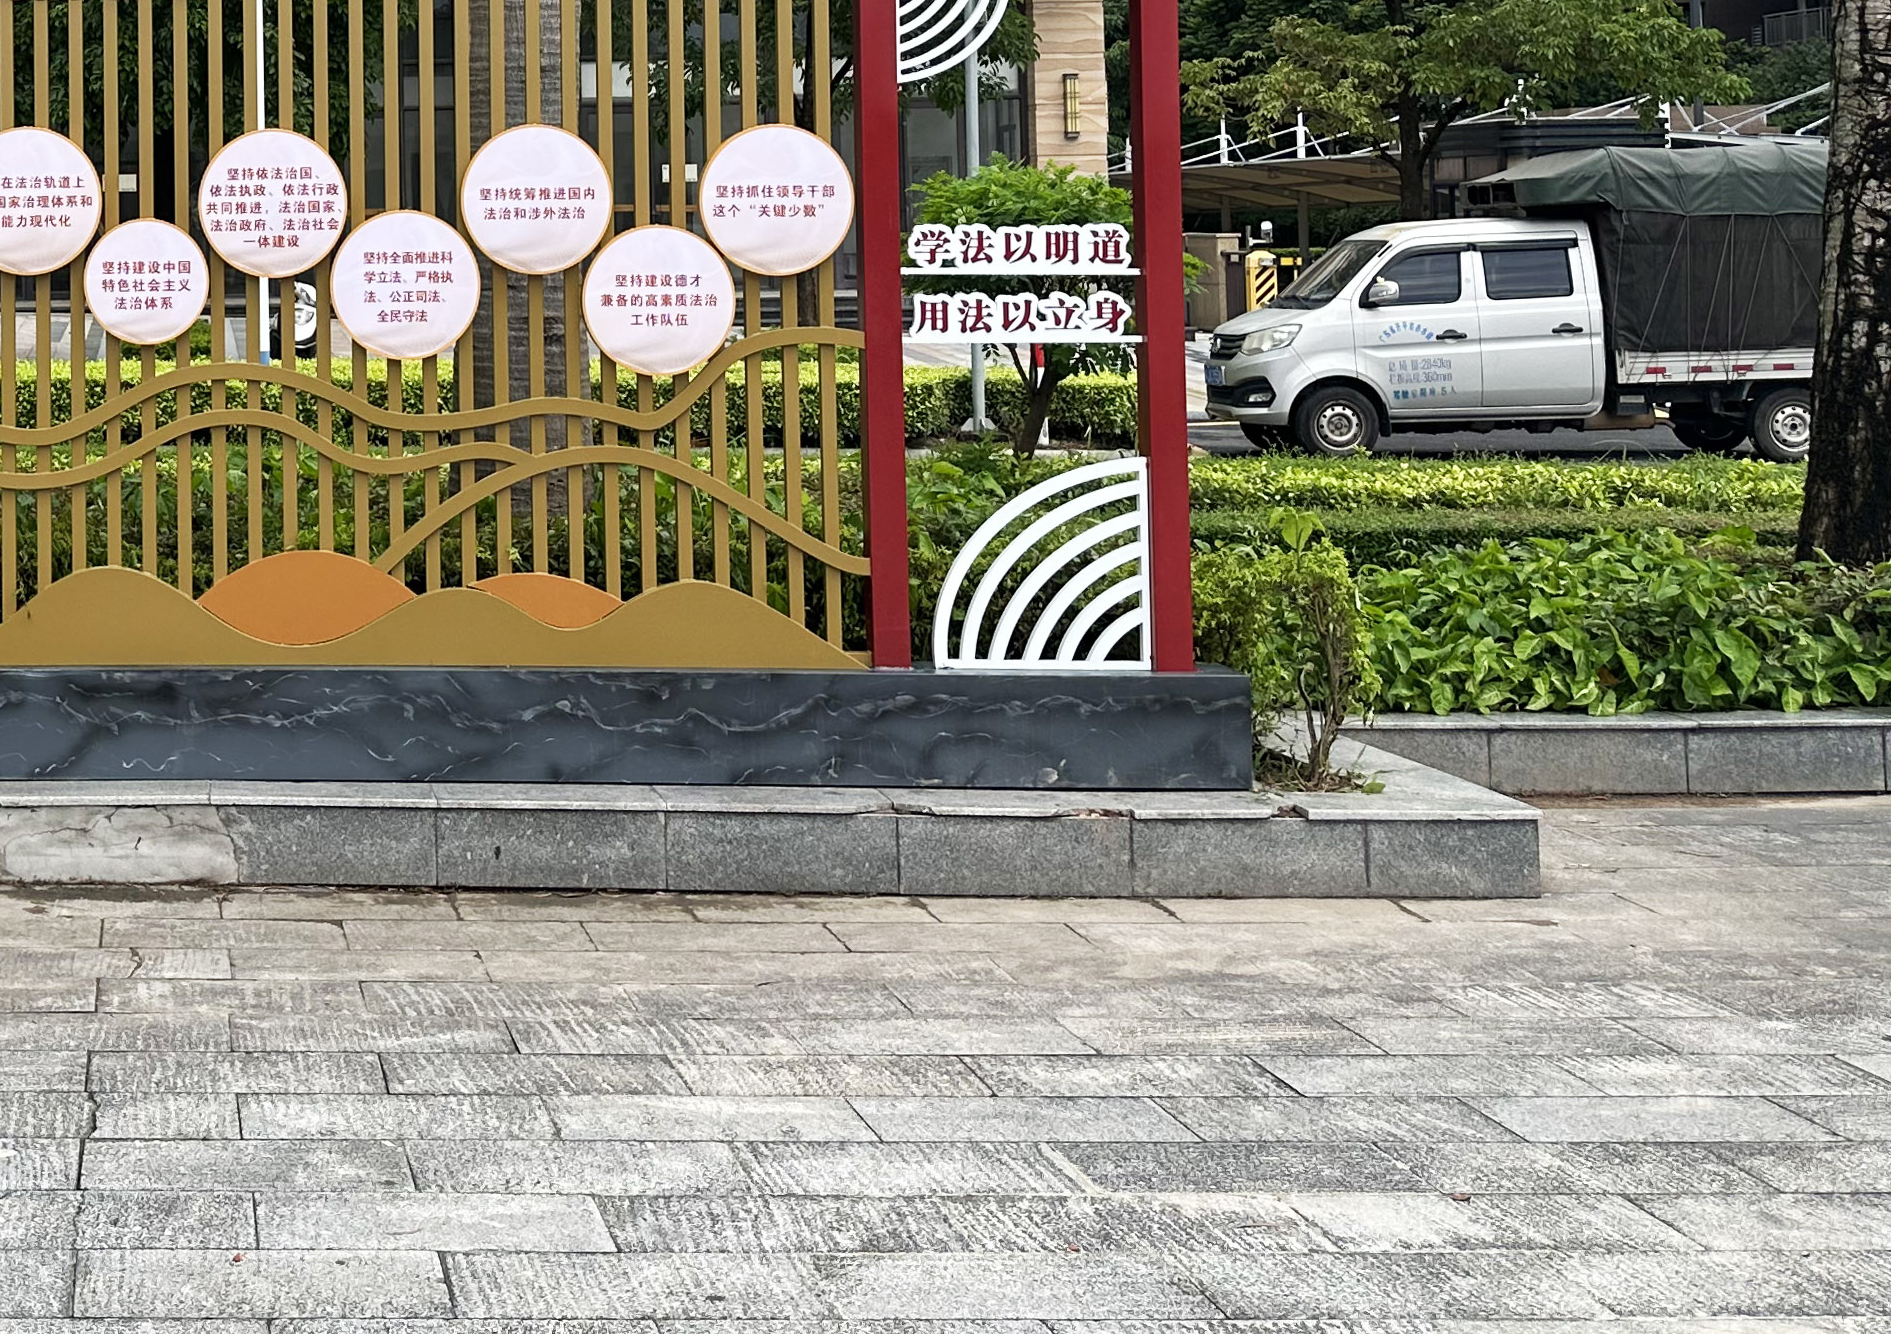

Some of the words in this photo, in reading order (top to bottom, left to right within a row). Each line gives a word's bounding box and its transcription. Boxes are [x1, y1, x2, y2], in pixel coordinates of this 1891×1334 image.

[227, 167, 319, 180] 坚持依法治国、
[210, 183, 338, 197] 依法执政、依法行政
[480, 187, 594, 200] 坚持统筹推进国内
[716, 185, 834, 198] 坚持抓住领导干部
[206, 200, 341, 214] 共同推进，法治国家、
[484, 207, 585, 220] 法治和涉外法治
[713, 204, 824, 217] 这个“关键少数”
[211, 218, 340, 232] 法治政府、法治社会
[244, 235, 299, 248] 一体建设
[914, 230, 1125, 265] 学法以明道
[364, 252, 452, 264] 坚持全面推进科
[103, 261, 190, 274] 坚持建设中国
[364, 271, 453, 283] 学立法、严格执
[616, 274, 701, 287] 坚持建设德才
[102, 279, 191, 292] 特色社会主义
[115, 297, 173, 310] 法治体系
[364, 291, 445, 303] 法、公正司法、
[601, 294, 717, 307] 兼备的高素质法治
[377, 310, 427, 322] 全民守法
[631, 314, 688, 326] 工作队伍
[917, 297, 1125, 333] 用法以立身
